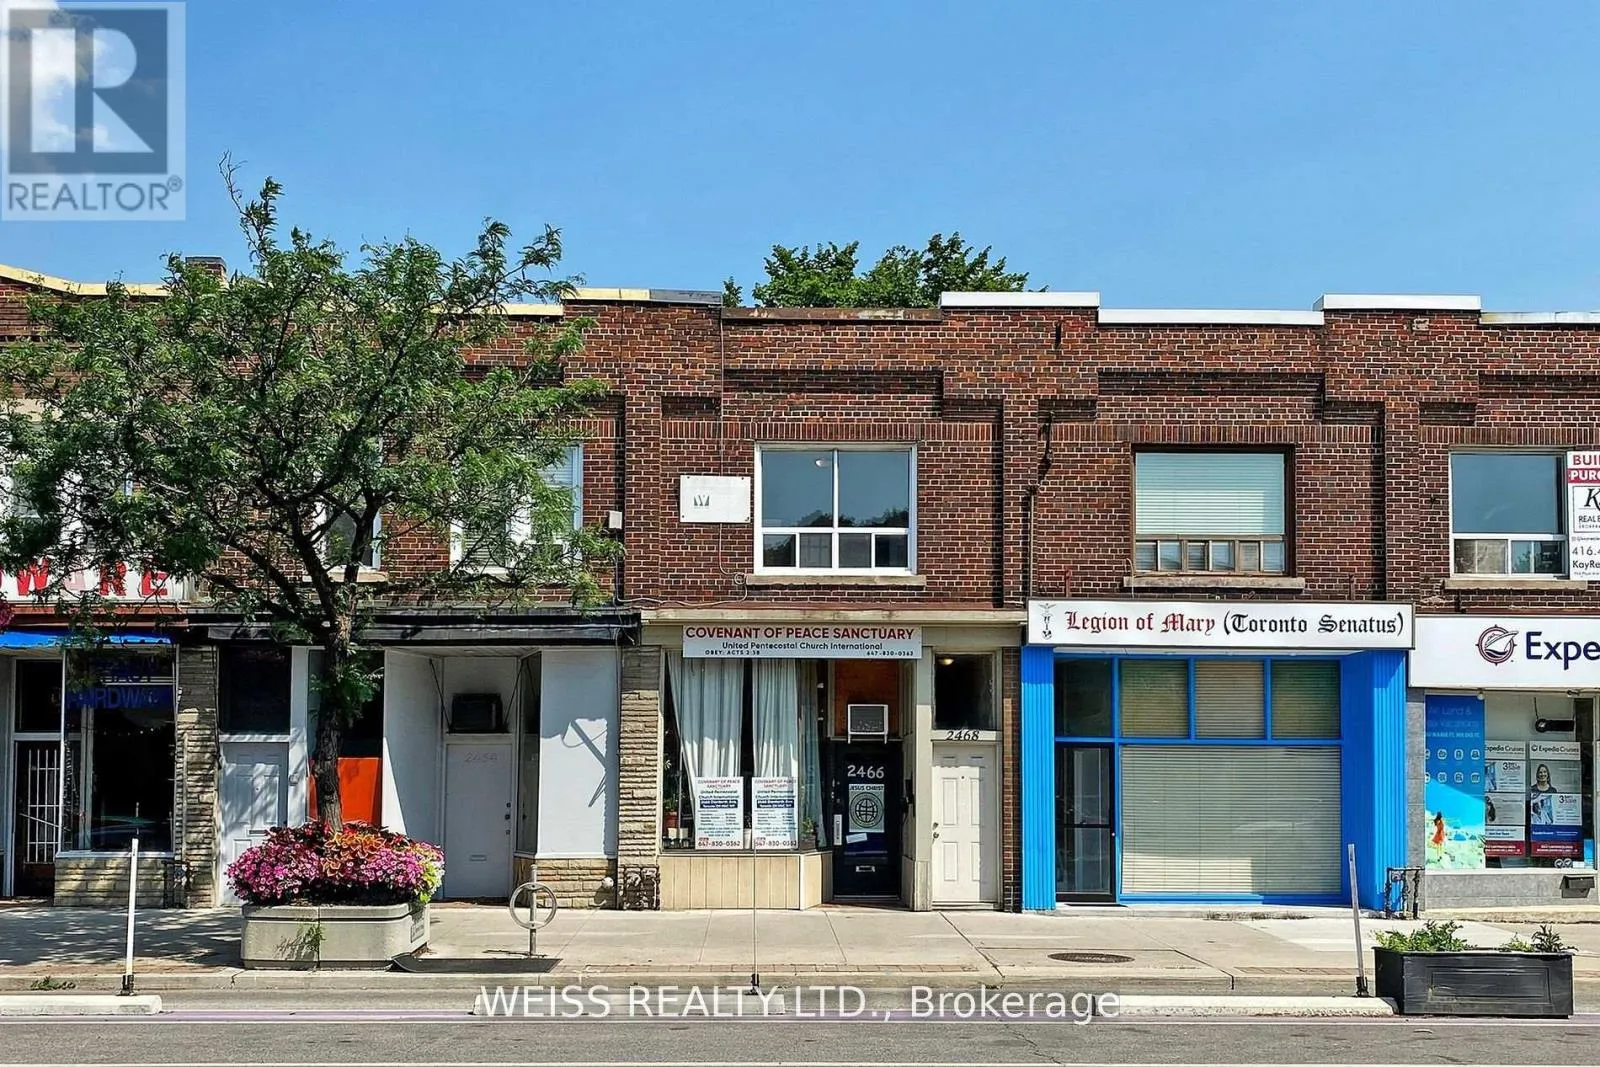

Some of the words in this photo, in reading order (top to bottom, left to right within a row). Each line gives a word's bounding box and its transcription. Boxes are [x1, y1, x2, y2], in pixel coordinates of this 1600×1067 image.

[1573, 455, 1600, 465] BUI
[1584, 488, 1600, 511] K
[1578, 515, 1596, 523] REAL
[1064, 611, 1129, 634] Legion
[1136, 612, 1154, 631] of
[1160, 612, 1216, 636] Mary
[1223, 610, 1308, 636] (Toronto
[1317, 611, 1405, 637] Senatus)
[685, 627, 760, 639] COVENANT
[763, 627, 783, 639] OF
[786, 627, 829, 639] PEACE
[833, 627, 914, 640] SANCTUARY
[722, 641, 749, 650] United
[750, 641, 798, 650] Pentecostal
[799, 642, 829, 650] Church
[830, 642, 883, 651] International
[1526, 630, 1600, 671] Expe
[944, 730, 980, 742] 2468
[1486, 745, 1504, 753] xpedia
[847, 764, 885, 779] 2466
